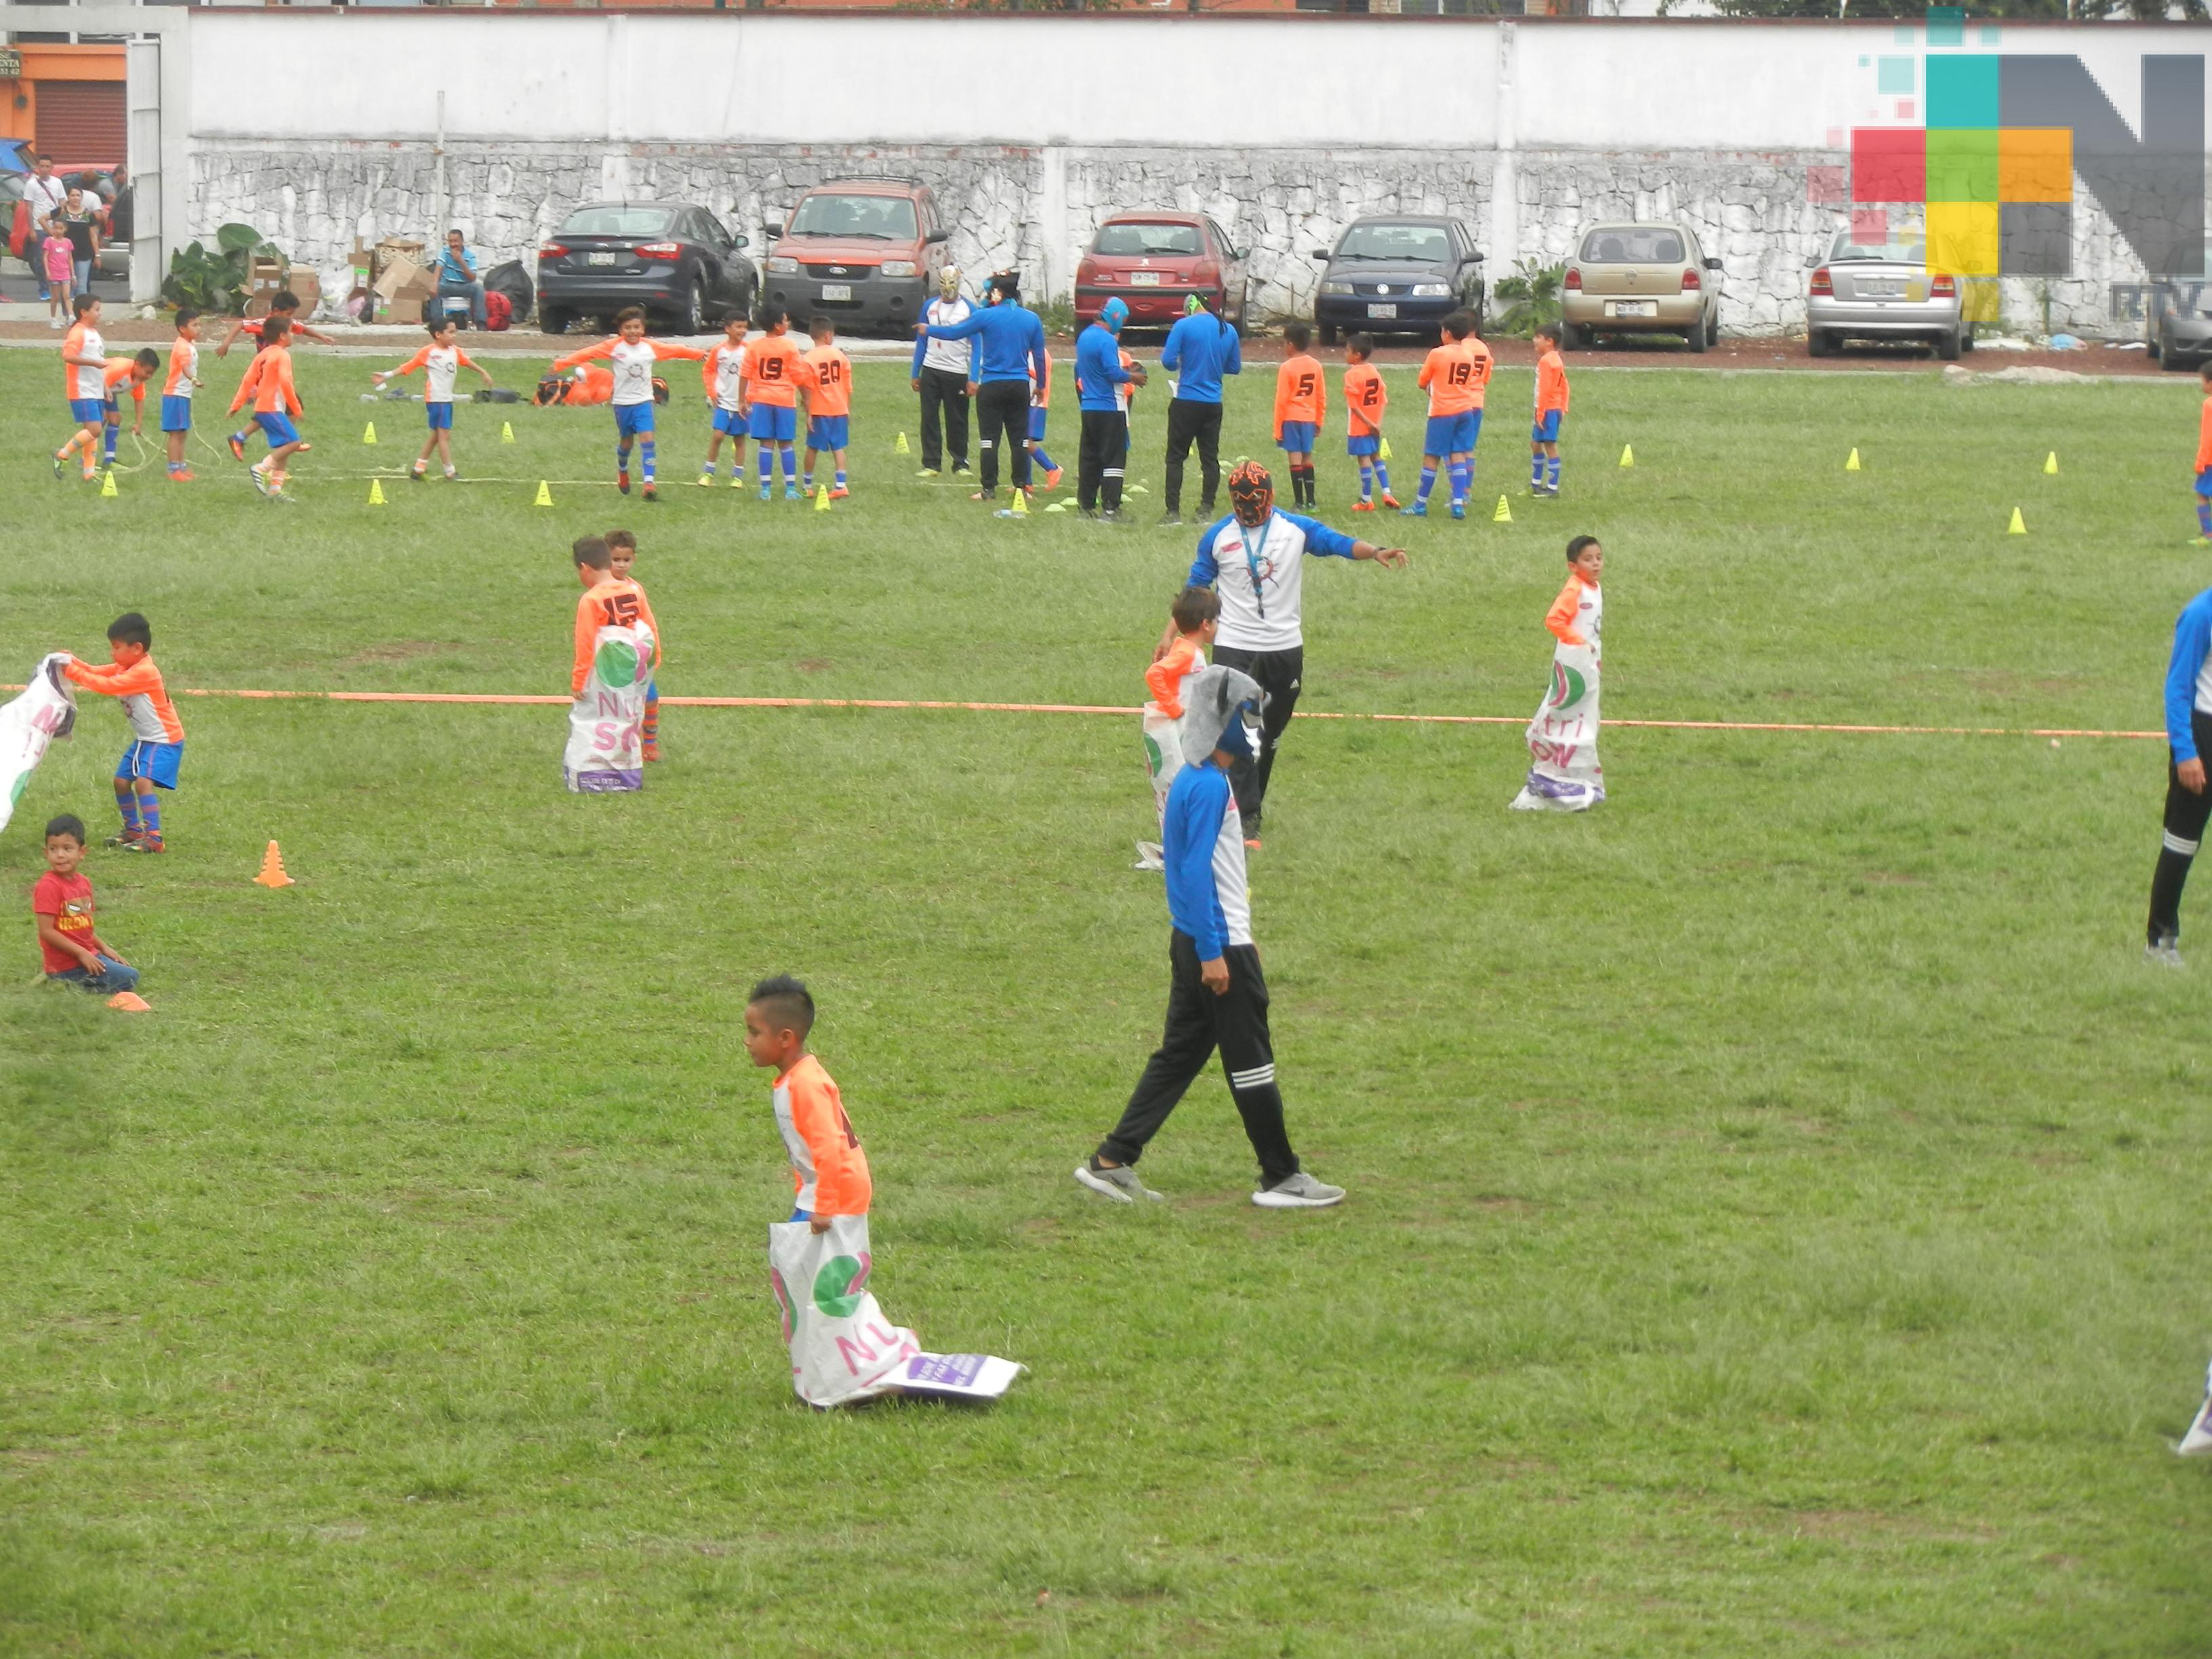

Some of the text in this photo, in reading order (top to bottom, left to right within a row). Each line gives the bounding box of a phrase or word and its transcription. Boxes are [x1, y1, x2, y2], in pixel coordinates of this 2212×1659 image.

[759, 356, 783, 380] 19
[818, 359, 840, 385] 20
[1448, 362, 1471, 385] 19
[1296, 373, 1315, 397] 5
[1363, 377, 1379, 407] 2
[602, 594, 640, 626] 15
